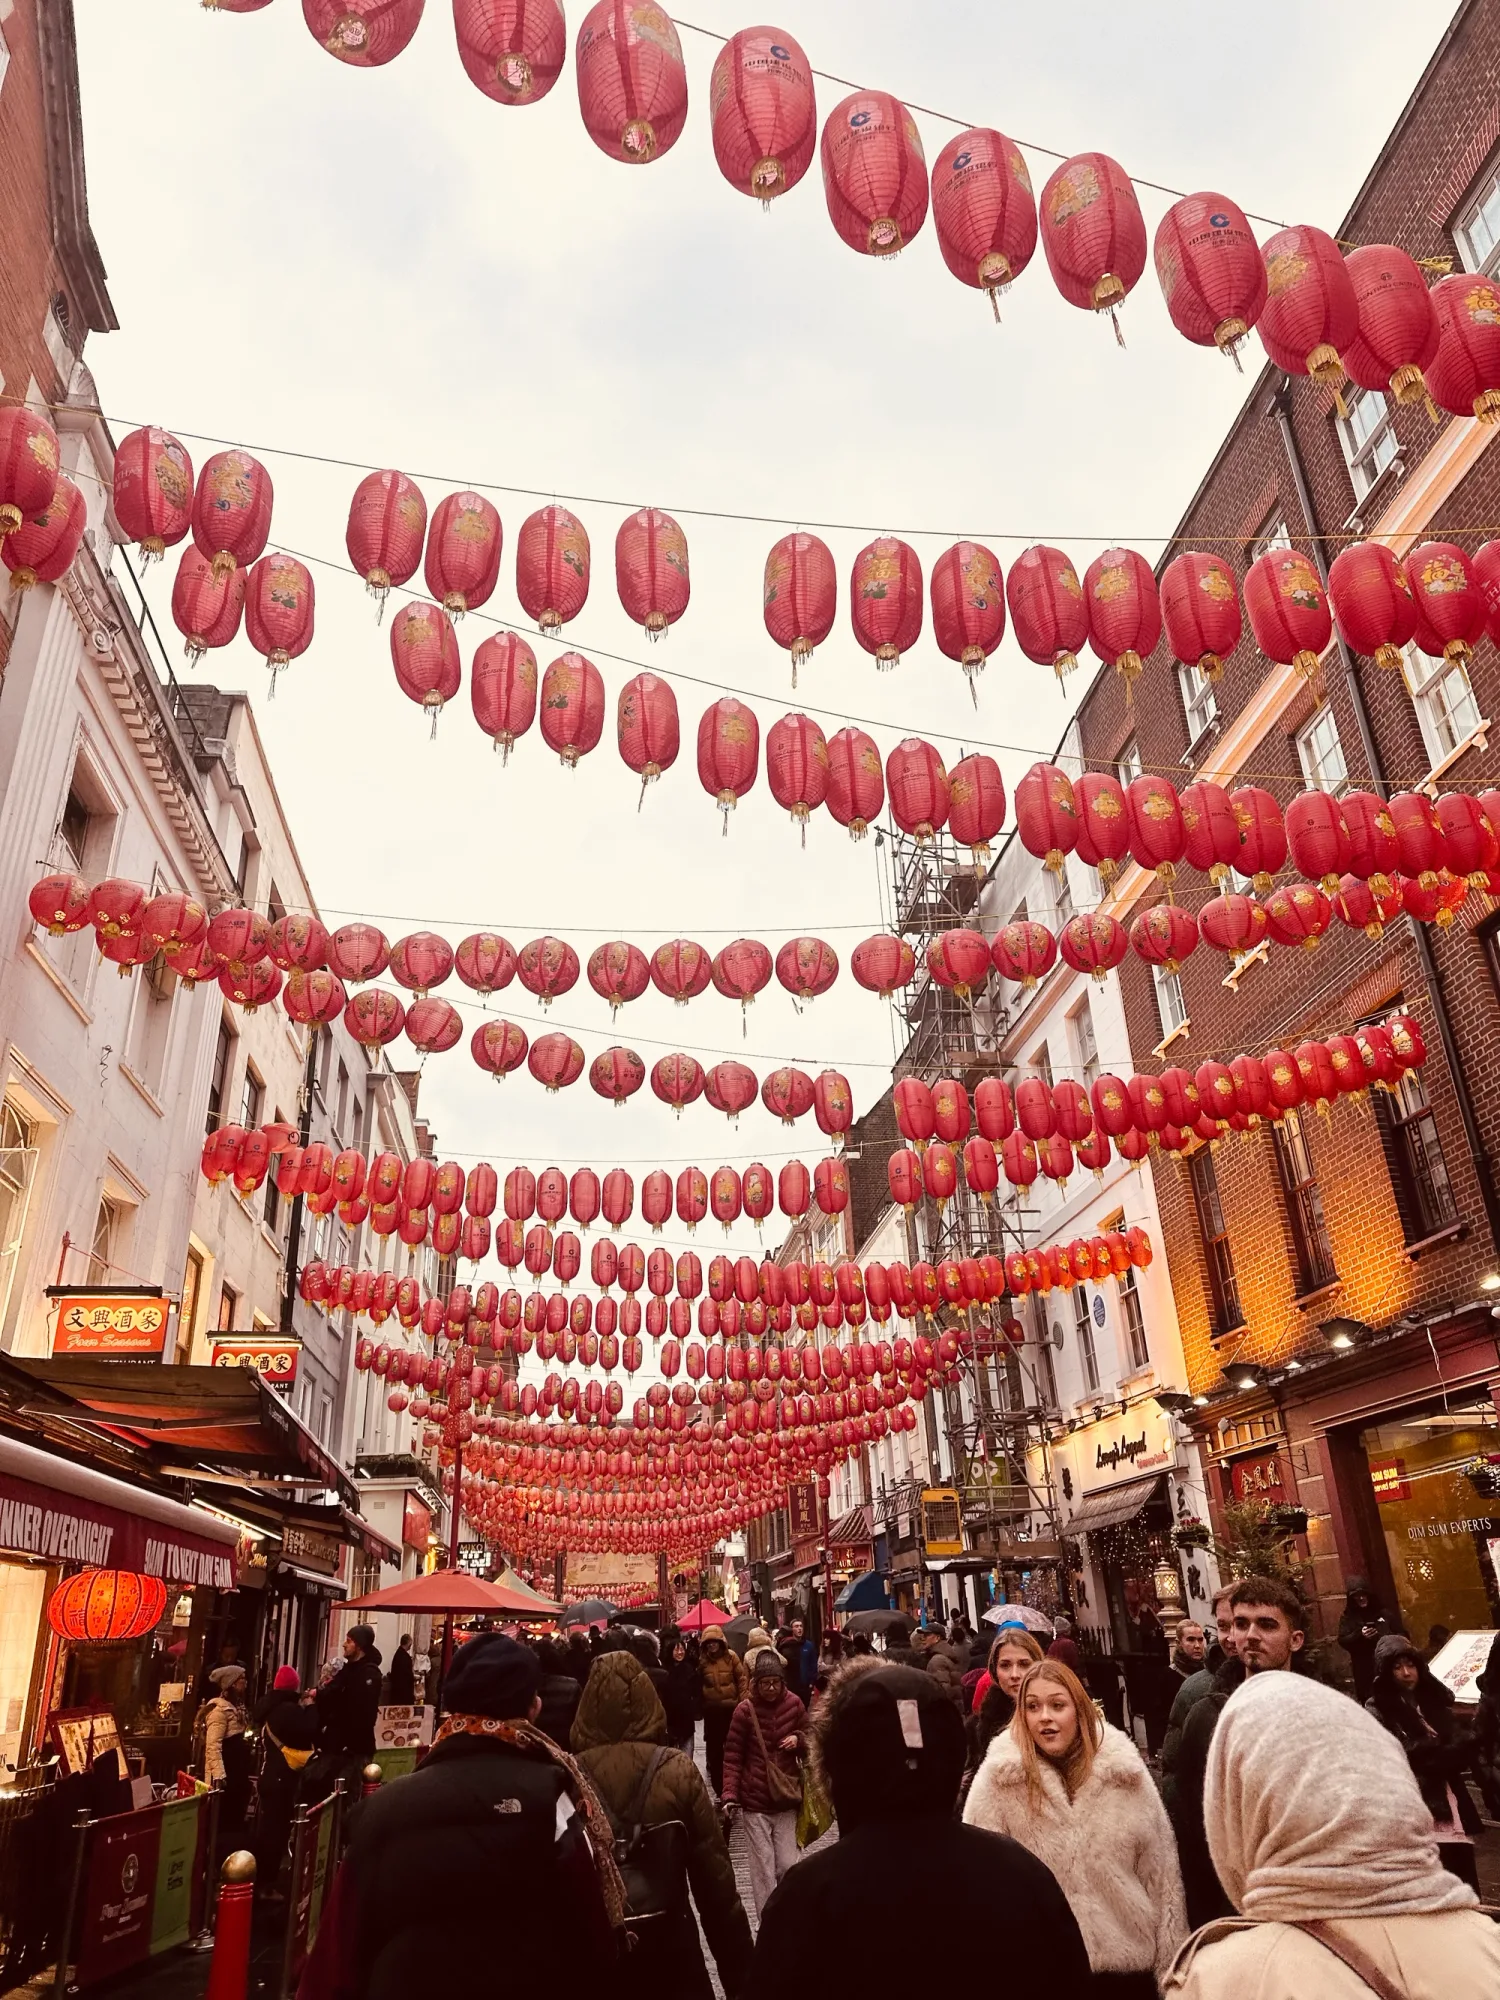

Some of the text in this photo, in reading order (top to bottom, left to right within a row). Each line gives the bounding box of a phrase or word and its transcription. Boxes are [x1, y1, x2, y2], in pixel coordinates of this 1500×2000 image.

[66, 1308, 158, 1329] 文興酒家
[67, 1334, 152, 1349] Four Seasons
[1371, 1468, 1398, 1482] DIM SUM
[1389, 1480, 1400, 1490] daily
[41, 1510, 114, 1567] OVERNIGHT
[1408, 1517, 1492, 1539] DIM SUM EXPERTS
[144, 1538, 233, 1589] 9AM TO NEXT DAY 5AM
